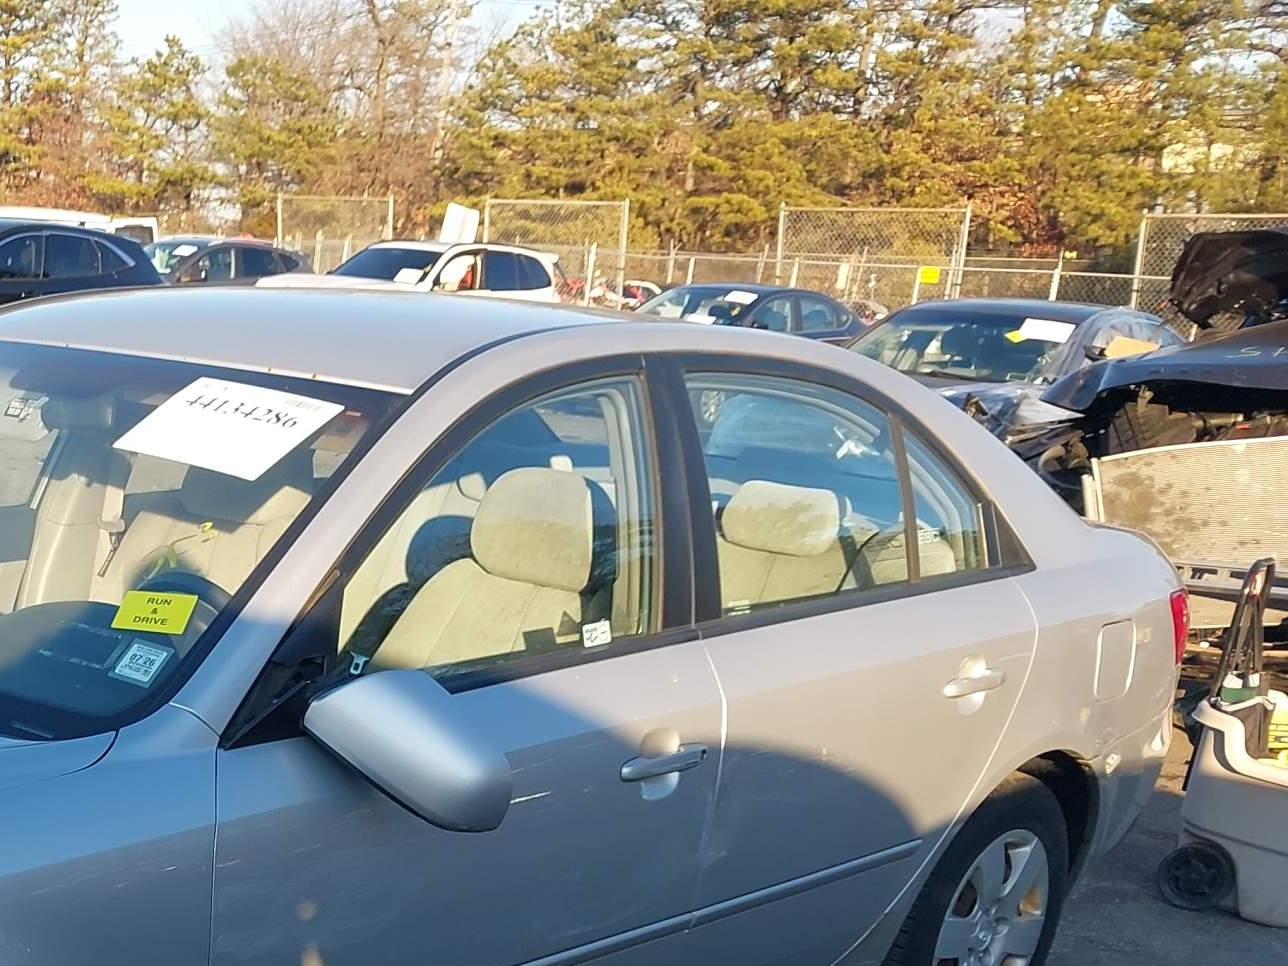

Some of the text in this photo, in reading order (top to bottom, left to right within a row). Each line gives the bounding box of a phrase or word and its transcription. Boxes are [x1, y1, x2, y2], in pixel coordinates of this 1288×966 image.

[185, 394, 300, 429] 44134286
[146, 597, 172, 606] RUN
[150, 607, 159, 615] &
[132, 615, 169, 626] DRIVE
